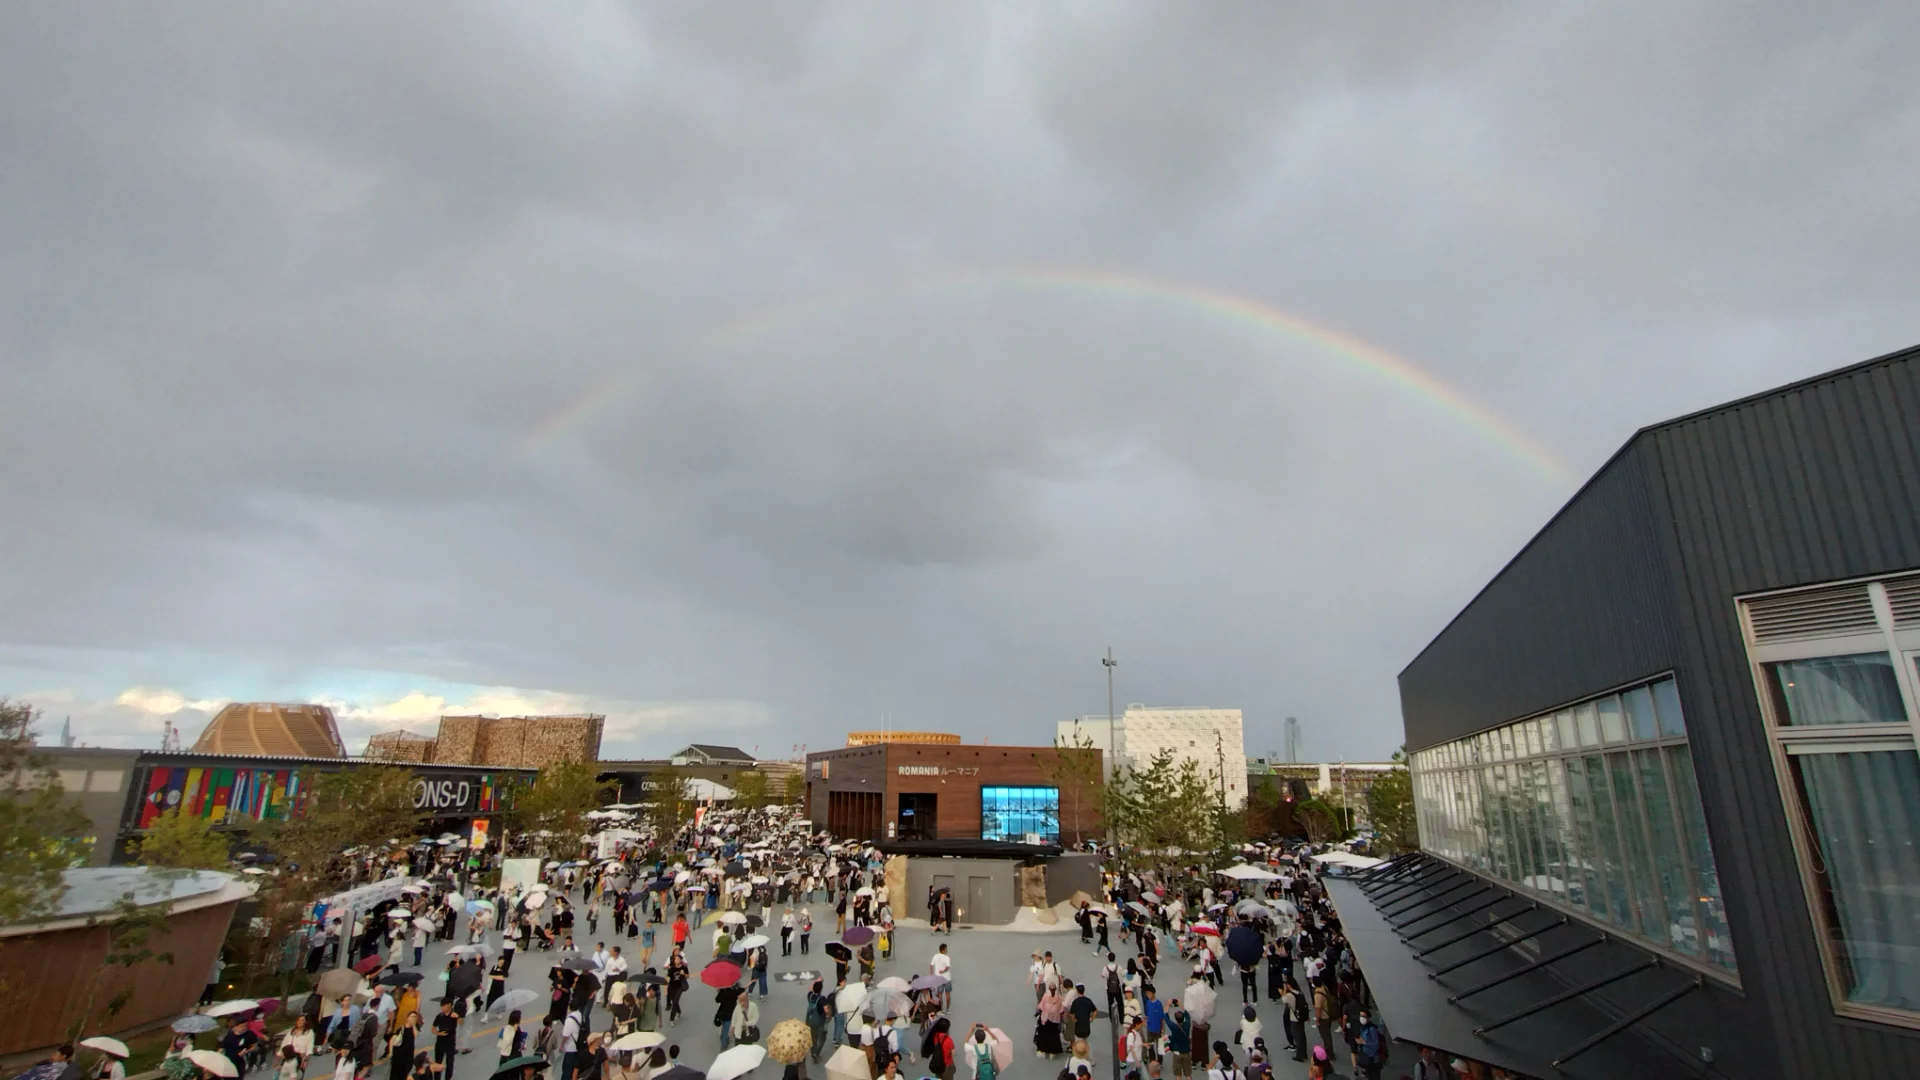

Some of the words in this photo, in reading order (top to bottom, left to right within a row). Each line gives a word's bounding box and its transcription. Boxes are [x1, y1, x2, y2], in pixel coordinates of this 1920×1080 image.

[898, 766, 939, 776] ROMANIA
[941, 767, 980, 777] ルーマニア
